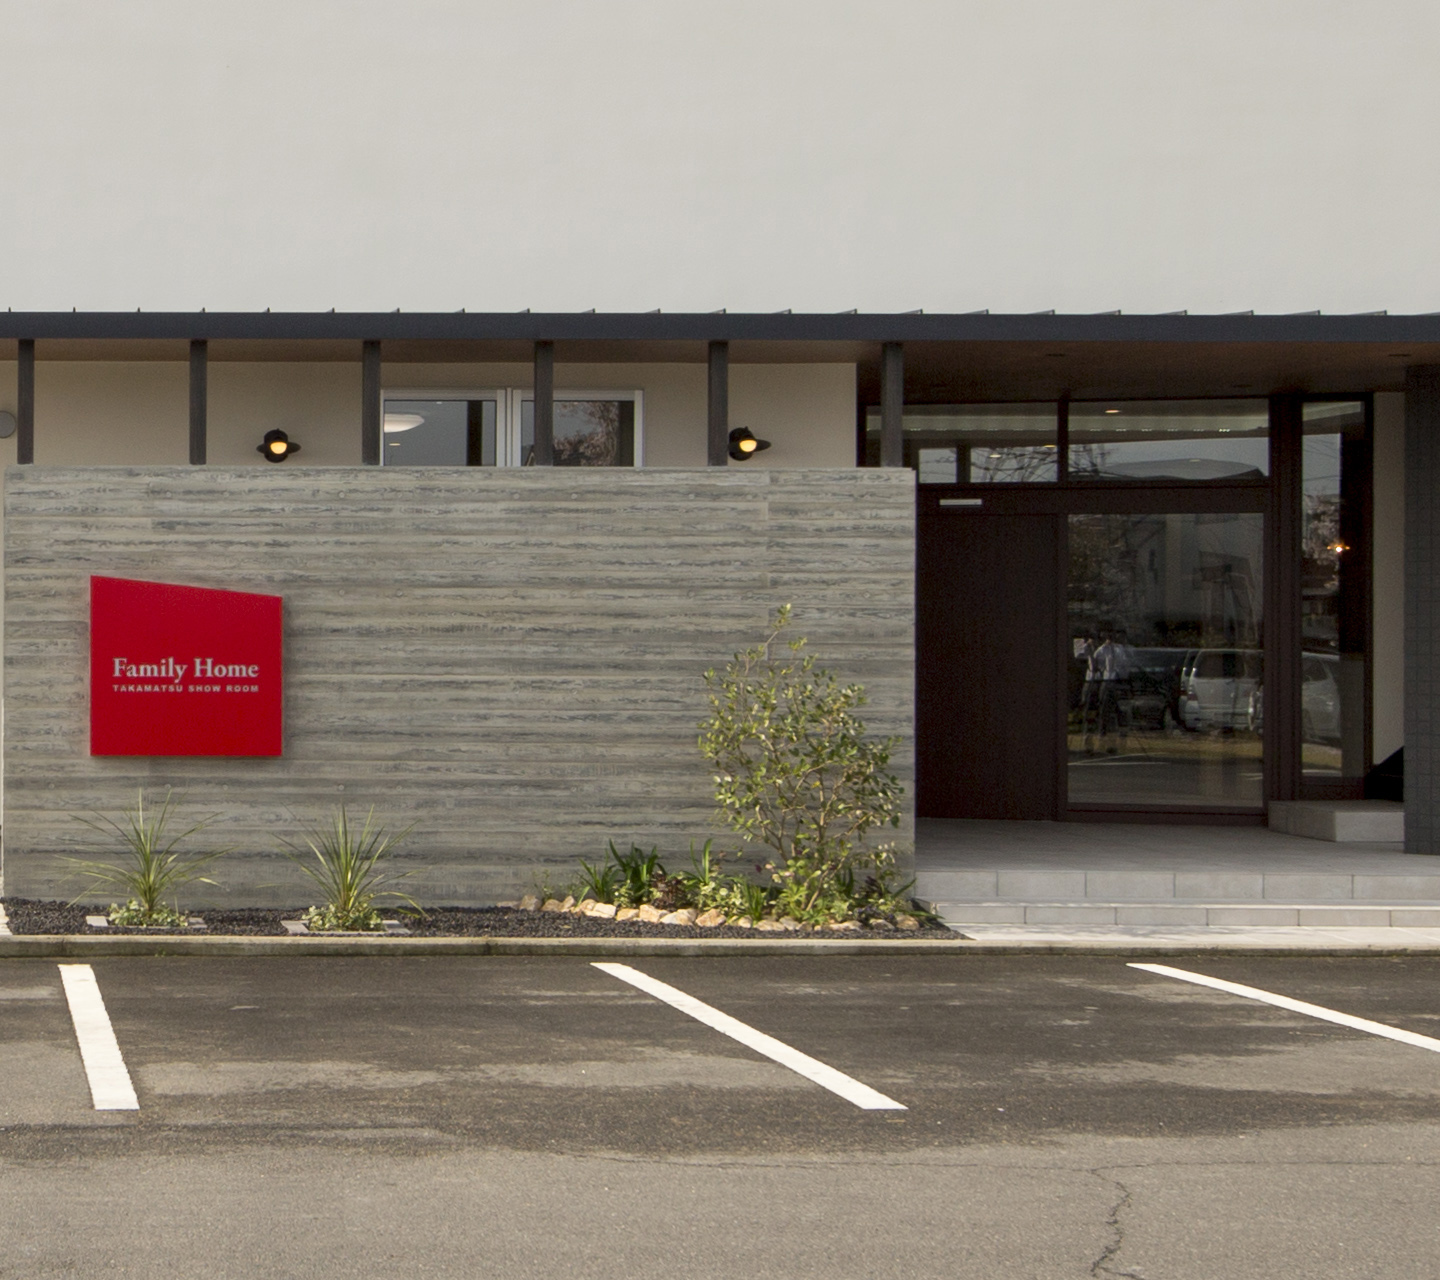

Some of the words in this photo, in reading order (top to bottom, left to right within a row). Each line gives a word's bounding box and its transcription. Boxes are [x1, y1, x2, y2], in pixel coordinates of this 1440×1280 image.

[112, 657, 188, 683] Family
[193, 657, 260, 679] Home
[112, 684, 184, 693] TAKAMATSU
[188, 684, 222, 693] SHOW
[226, 684, 260, 693] ROOM
